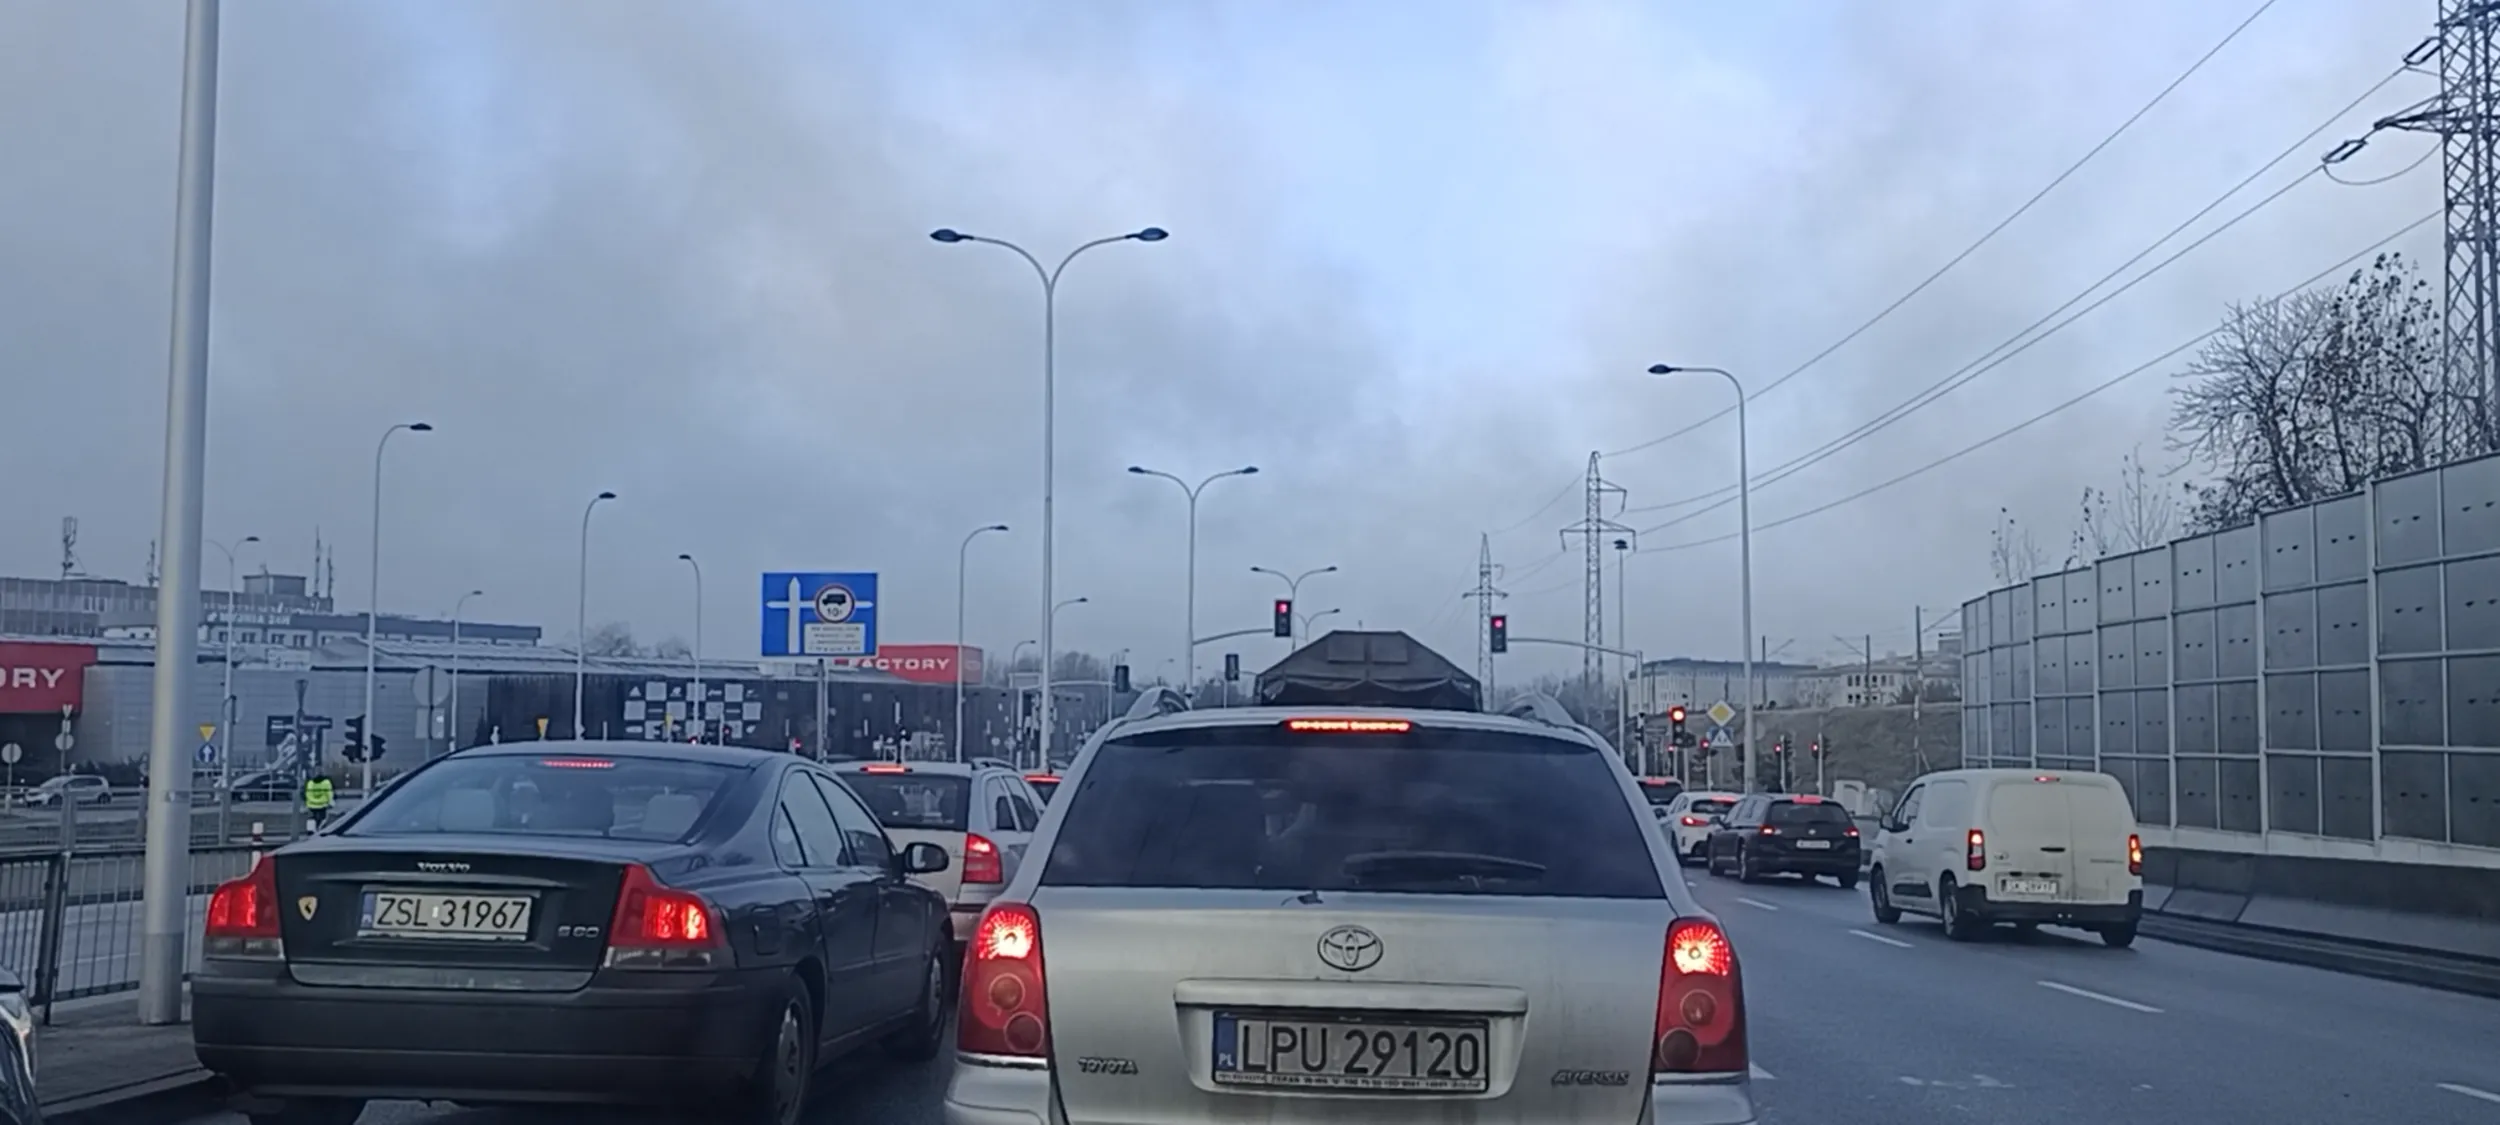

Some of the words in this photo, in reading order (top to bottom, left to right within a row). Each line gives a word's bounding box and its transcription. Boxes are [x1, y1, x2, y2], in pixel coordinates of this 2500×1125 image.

[0, 667, 65, 688] RY
[417, 861, 470, 872] VOLVO
[376, 897, 428, 926] ZSL
[439, 899, 527, 930] 31967
[1218, 1053, 1233, 1067] PL
[1242, 1025, 1327, 1073] LPU
[1343, 1029, 1479, 1078] 29120
[1078, 1057, 1139, 1074] TOYOTA
[1551, 1069, 1629, 1086] AVENSIS
